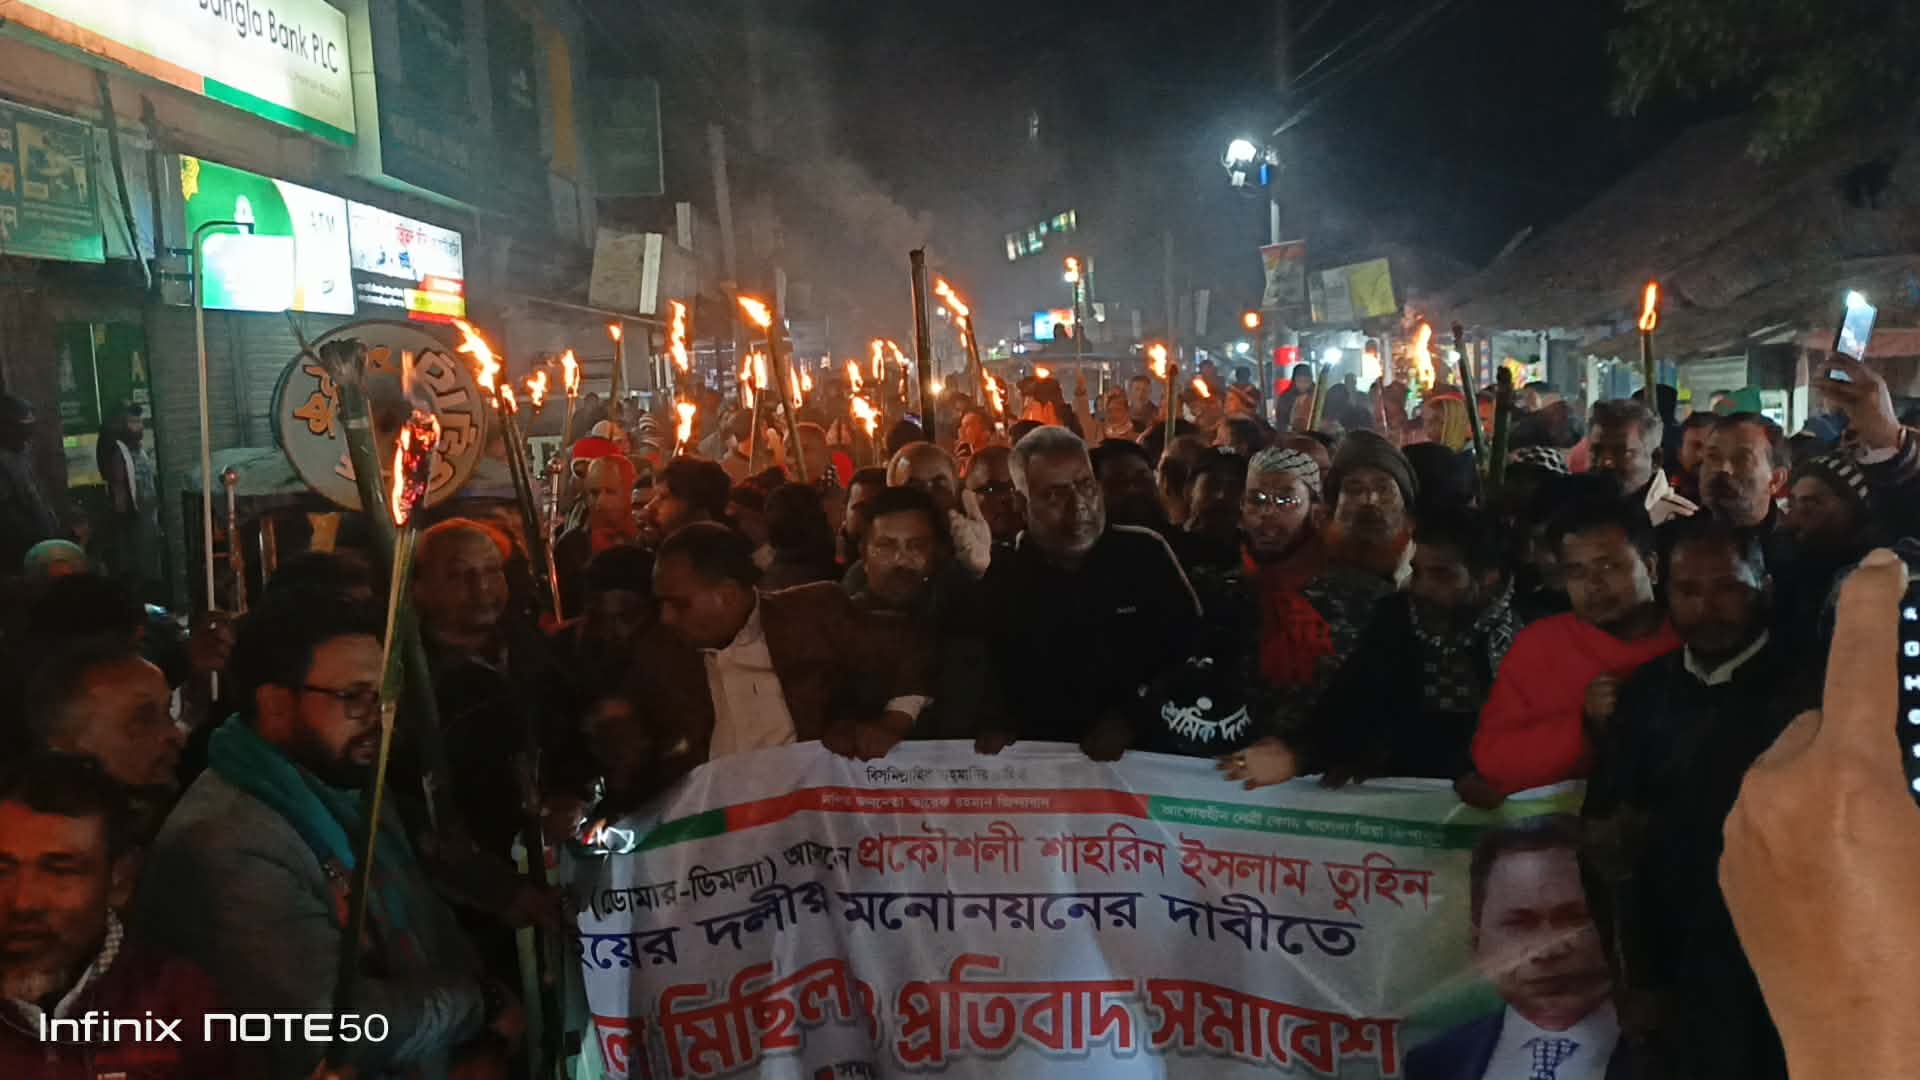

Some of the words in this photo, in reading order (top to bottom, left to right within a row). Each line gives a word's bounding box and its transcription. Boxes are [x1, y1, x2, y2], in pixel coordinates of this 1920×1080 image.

[199, 0, 263, 38] angla
[267, 9, 309, 60] Bank
[311, 31, 339, 73] PLC
[857, 820, 1024, 876] প্রকৌশলী
[1036, 821, 1168, 880] শাহরিন
[1178, 832, 1313, 896] ইসলাম
[1322, 852, 1436, 916] তুহিন
[834, 889, 1143, 932] মনোনয়নের
[1159, 892, 1364, 957] দাবীতে
[659, 957, 852, 1079] মিছিল
[896, 952, 1136, 1065] প্রতিবাদ
[1146, 977, 1405, 1074] সমাবেশ
